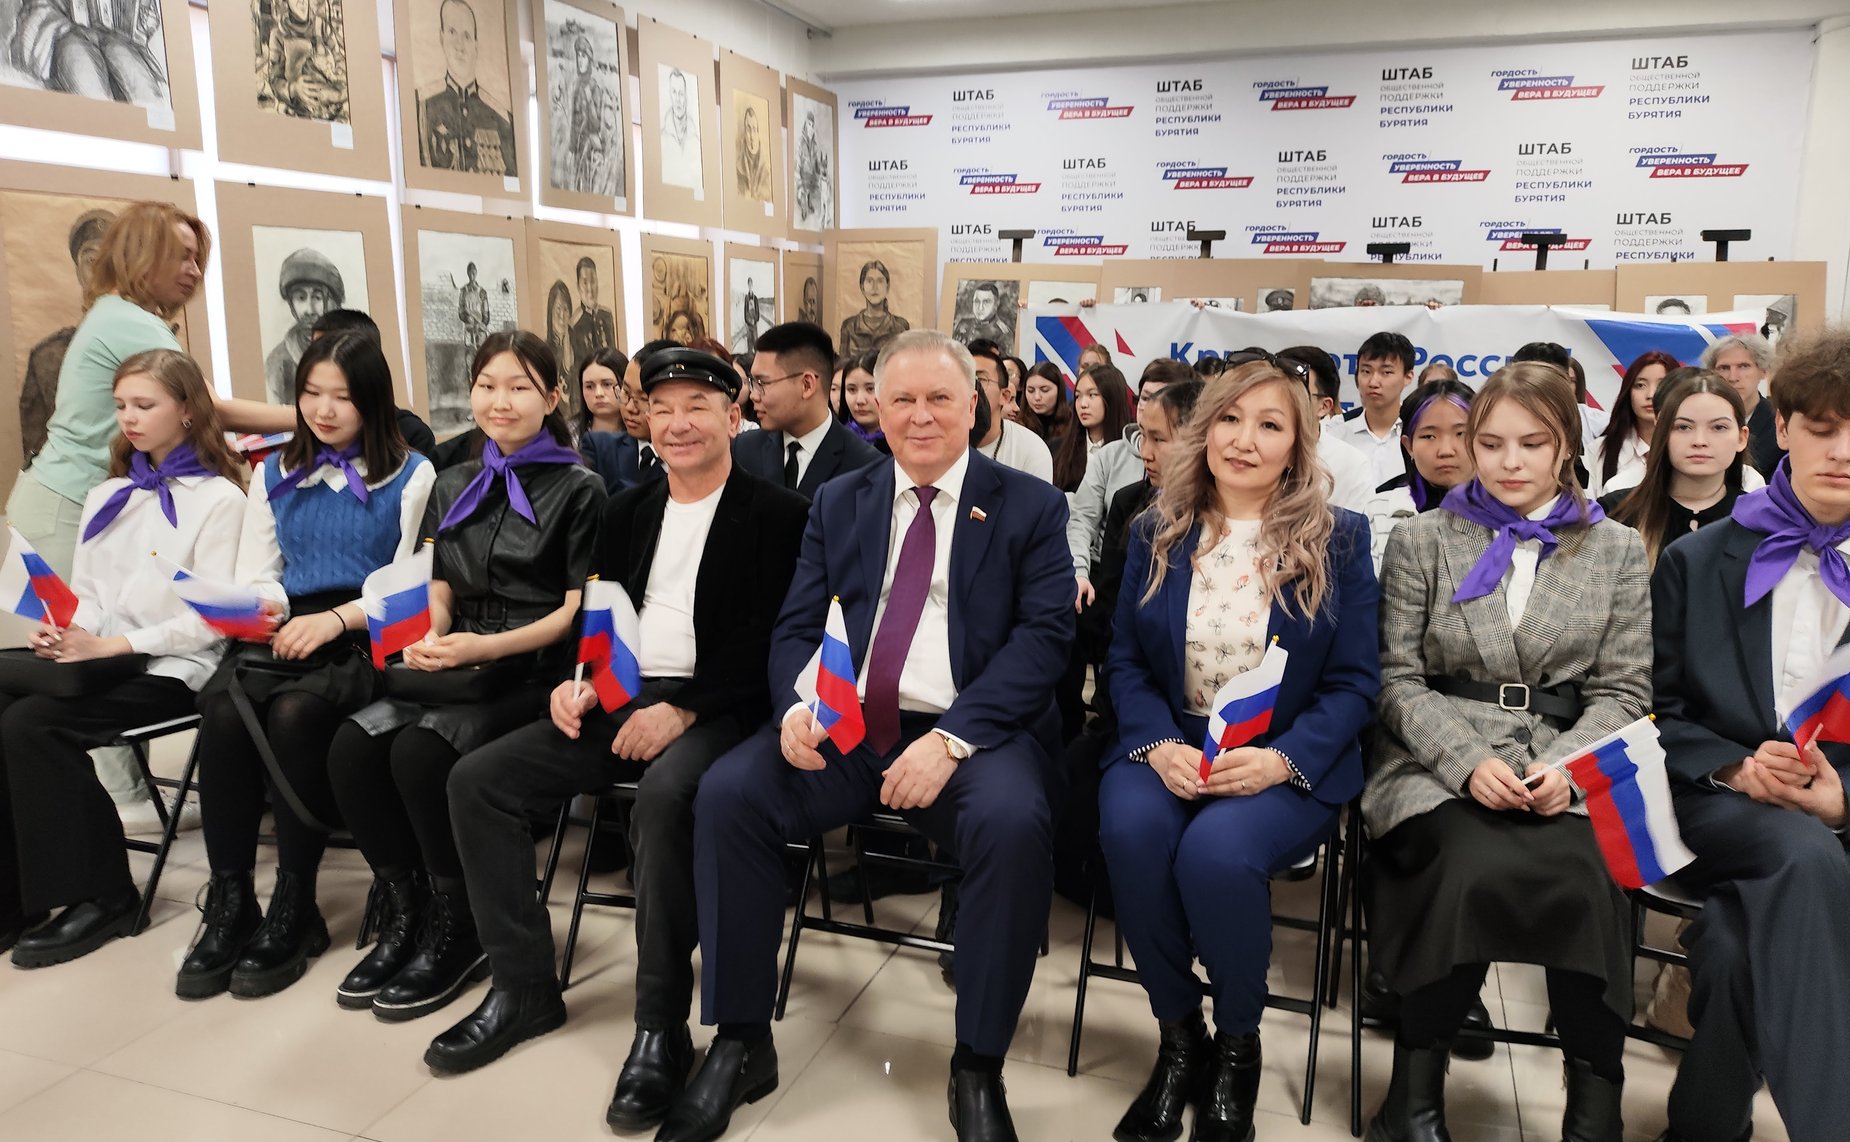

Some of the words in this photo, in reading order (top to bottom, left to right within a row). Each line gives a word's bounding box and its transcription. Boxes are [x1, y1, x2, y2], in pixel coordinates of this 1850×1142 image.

[1632, 56, 1688, 70] ШТАБ
[1382, 67, 1433, 80] ШТАБ
[1630, 72, 1700, 82] ОБЩЕСТВЕННОЙ
[1157, 80, 1203, 93] ШТАБ
[1380, 82, 1444, 92] ОБЩЕСТВЕННОЙ
[1503, 79, 1568, 88] УВЕРЕННОСТЬ
[1629, 82, 1699, 92] ПОДДЕРЖКИ
[953, 90, 994, 101] ШТАБ
[1264, 89, 1323, 99] УВЕРЕННОСТЬ
[1380, 92, 1443, 102] ПОДДЕРЖКИ
[1518, 89, 1542, 99] ВЕРА
[1544, 89, 1550, 98] В
[1552, 88, 1597, 97] БУДУЩЕЕ
[1051, 100, 1104, 108] УВЕРЕННОСТЬ
[1277, 100, 1300, 109] ВЕРА
[1301, 100, 1307, 108] В
[1309, 98, 1349, 107] БУДУЩЕЕ
[1629, 96, 1710, 106] РЕСПУБЛИКИ
[1155, 103, 1212, 112] ПОДДЕРЖКИ
[1380, 105, 1453, 114] РЕСПУБЛИКИ
[857, 108, 906, 117] УВЕРЕННОСТЬ
[1063, 110, 1083, 118] ВЕРА
[1091, 109, 1128, 117] БУДУЩЕЕ
[1628, 110, 1681, 119] БУРЯТИЯ
[869, 118, 887, 126] ВЕРА
[889, 118, 893, 126] В
[895, 117, 928, 126] БУДУЩЕЕ
[1156, 115, 1221, 124] РЕСПУБЛИКИ
[1380, 119, 1428, 128] БУРЯТИЯ
[951, 124, 1010, 132] РЕСПУБЛИКИ
[1155, 128, 1199, 136] БУРЯТИЯ
[1519, 143, 1571, 155] ШТАБ
[1278, 150, 1326, 162] ШТАБ
[1641, 156, 1710, 165] УВЕРЕННОСТЬ
[869, 160, 907, 171] ШТАБ
[1063, 158, 1106, 169] ШТАБ
[1394, 162, 1456, 171] УВЕРЕННОСТЬ
[1166, 170, 1222, 178] УВЕРЕННОСТЬ
[1516, 168, 1583, 176] ПОДДЕРЖКИ
[1657, 167, 1682, 176] ВЕРА
[1684, 167, 1691, 176] В
[1692, 166, 1741, 176] БУДУЩЕЕ
[963, 176, 1013, 184] УВЕРЕННОСТЬ
[1277, 173, 1337, 183] ПОДДЕРЖКИ
[1408, 173, 1431, 182] ВЕРА
[1433, 173, 1439, 181] В
[1441, 172, 1484, 181] БУДУЩЕЕ
[1179, 180, 1200, 188] ВЕРА
[1209, 179, 1248, 187] БУДУЩЕЕ
[1516, 181, 1592, 190] РЕСПУБЛИКИ
[975, 185, 994, 193] ВЕРА
[995, 185, 1000, 193] В
[1002, 184, 1036, 193] БУДУЩЕЕ
[1277, 186, 1345, 195] РЕСПУБЛИКИ
[869, 192, 925, 200] РЕСПУБЛИКИ
[1061, 192, 1123, 200] РЕСПУБЛИКИ
[1276, 200, 1322, 208] БУРЯТИЯ
[1372, 216, 1422, 228] ШТАБ
[1616, 213, 1672, 225] ШТАБ
[951, 225, 991, 235] ШТАБ
[1151, 221, 1195, 232] ШТАБ
[1615, 229, 1683, 237] ОБЩЕСТВЕННОЙ
[1047, 237, 1099, 245] УВЕРЕННОСТЬ
[1255, 234, 1314, 242] УВЕРЕННОСТЬ
[1615, 238, 1682, 246] ПОДДЕРЖКИ
[1087, 246, 1123, 254] БУДУЩЕЕ
[1150, 243, 1200, 251] ПОДДЕРЖК
[1269, 244, 1291, 252] ВЕРА
[1300, 243, 1340, 251] БУДУЩЕЕ
[1616, 251, 1694, 260] РЕСПУБЛИКИ
